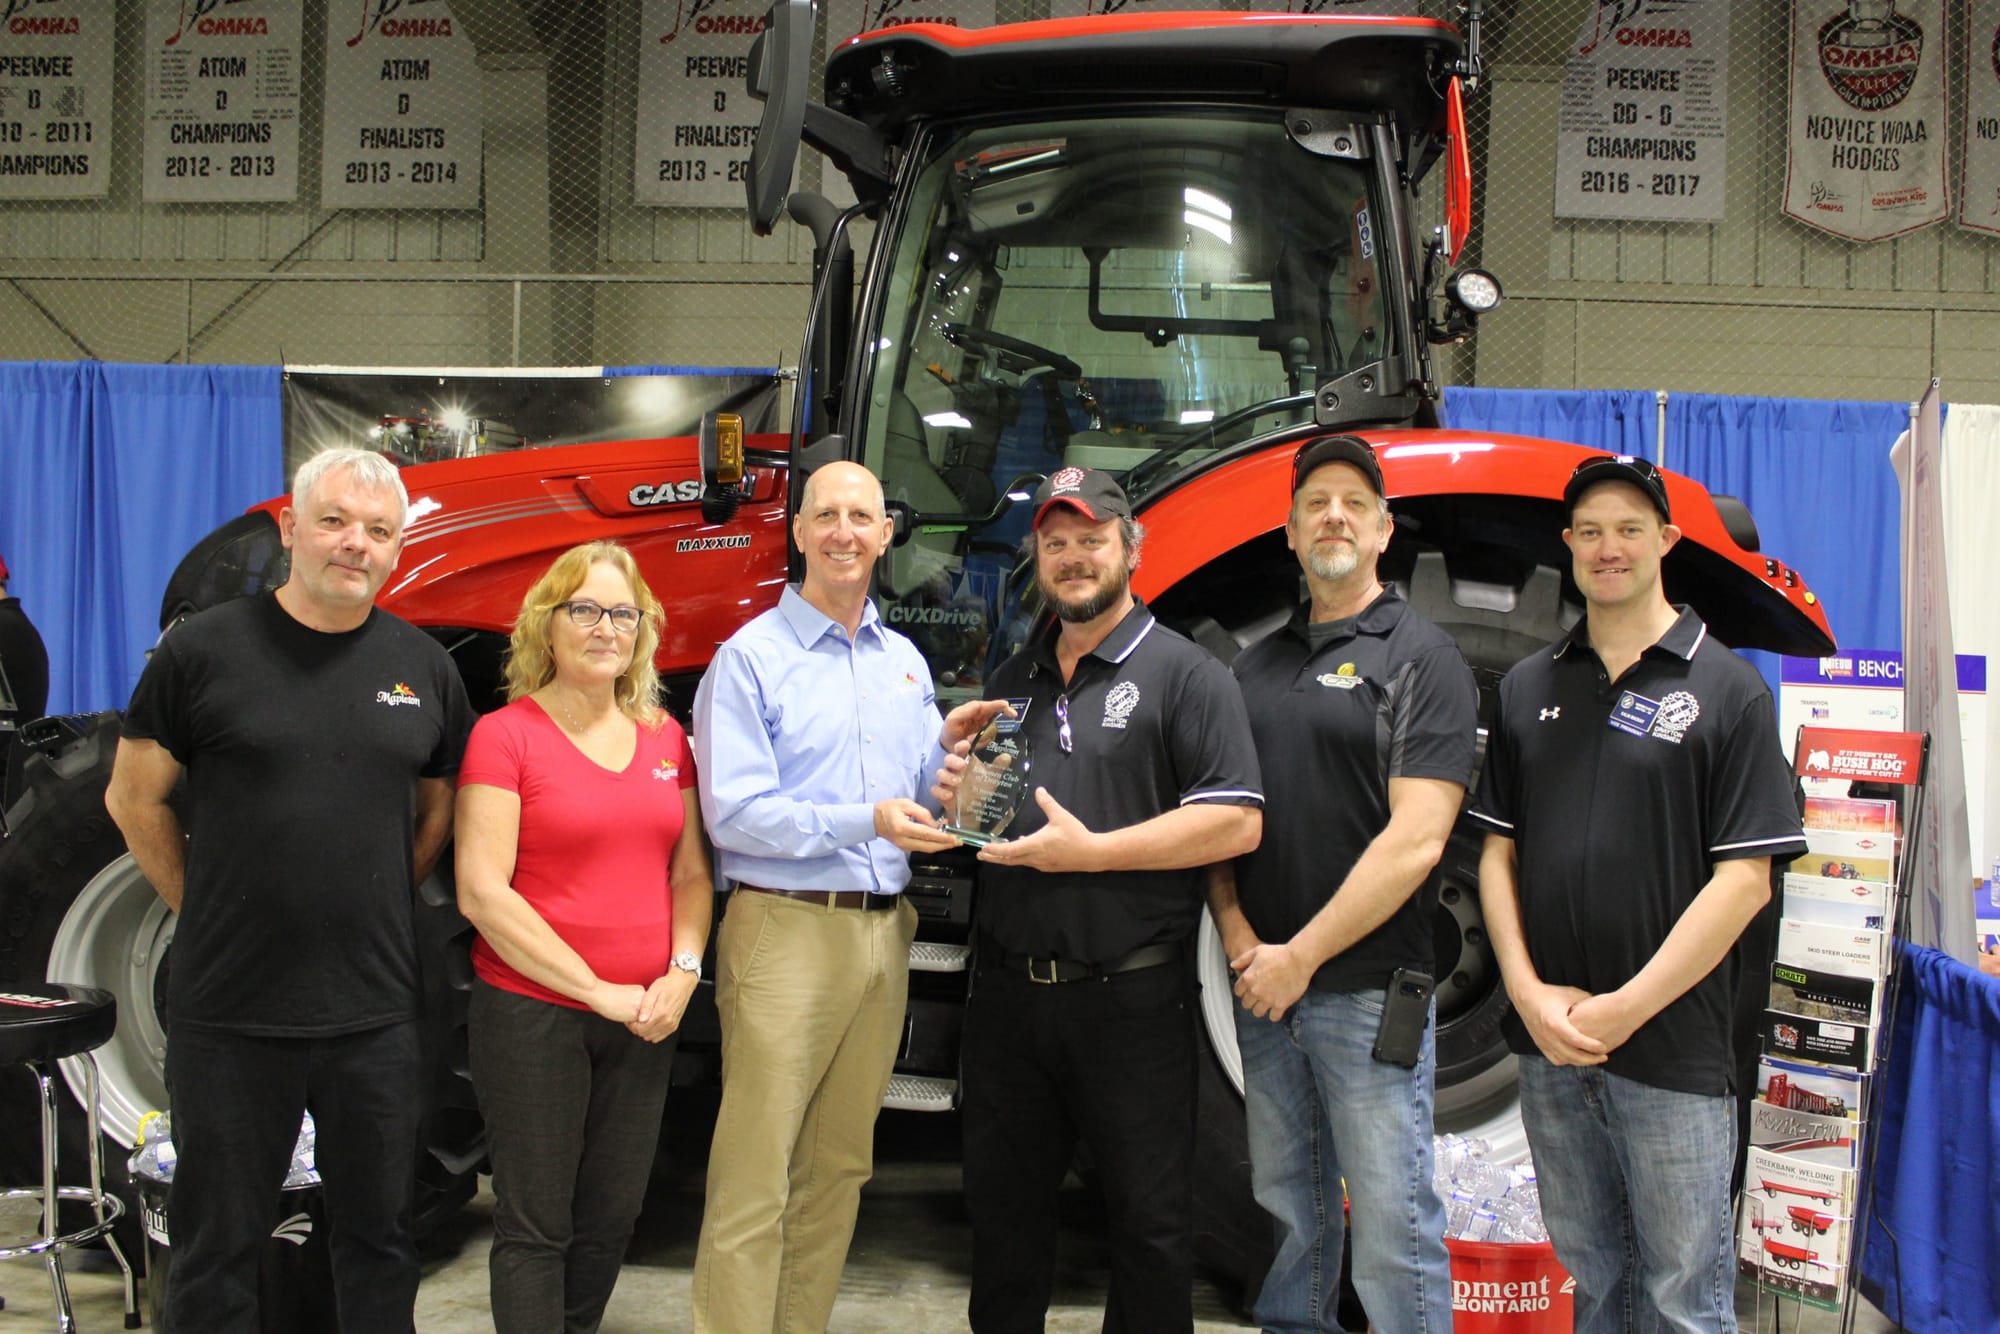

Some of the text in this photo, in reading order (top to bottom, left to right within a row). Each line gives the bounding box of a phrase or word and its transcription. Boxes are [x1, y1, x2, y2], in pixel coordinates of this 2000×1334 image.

[9, 17, 80, 35] OMHA
[198, 17, 268, 35] OMHA
[380, 18, 453, 37] OMHA
[1615, 27, 1692, 48] OMHA
[1824, 43, 1917, 68] OMHA
[199, 57, 247, 77] ATOM
[380, 59, 430, 80] ATOM
[686, 56, 748, 78] PEEWE
[1607, 67, 1681, 92] PEEWEE
[45, 122, 92, 143] 2011
[171, 122, 271, 143] CHAMPIONS
[360, 127, 445, 149] FINALISTS
[1806, 115, 1876, 144] NOVICE
[1977, 118, 2000, 140] NO
[1586, 136, 1696, 161] CHAMPIONS
[1832, 145, 1900, 171] HODGES
[0, 155, 89, 176] AMPIONS
[166, 157, 210, 177] 2012
[230, 156, 275, 177] 2013
[345, 162, 390, 183] 2013
[411, 162, 457, 183] 2014
[659, 160, 706, 181] 2013
[1581, 171, 1630, 193] 2016
[1652, 174, 1700, 196] 2017
[629, 480, 709, 506] CAS
[676, 535, 751, 552] MAXXUM
[889, 606, 982, 625] CVXDrive
[376, 691, 421, 708] Mapleton
[1832, 756, 1869, 769] BUSH
[1776, 969, 1805, 983] SCHULTE
[1754, 1109, 1841, 1143] Kwik-Till
[1755, 1156, 1835, 1182] CREEKBANK WELDING
[1467, 1297, 1550, 1313] ONTARIO
